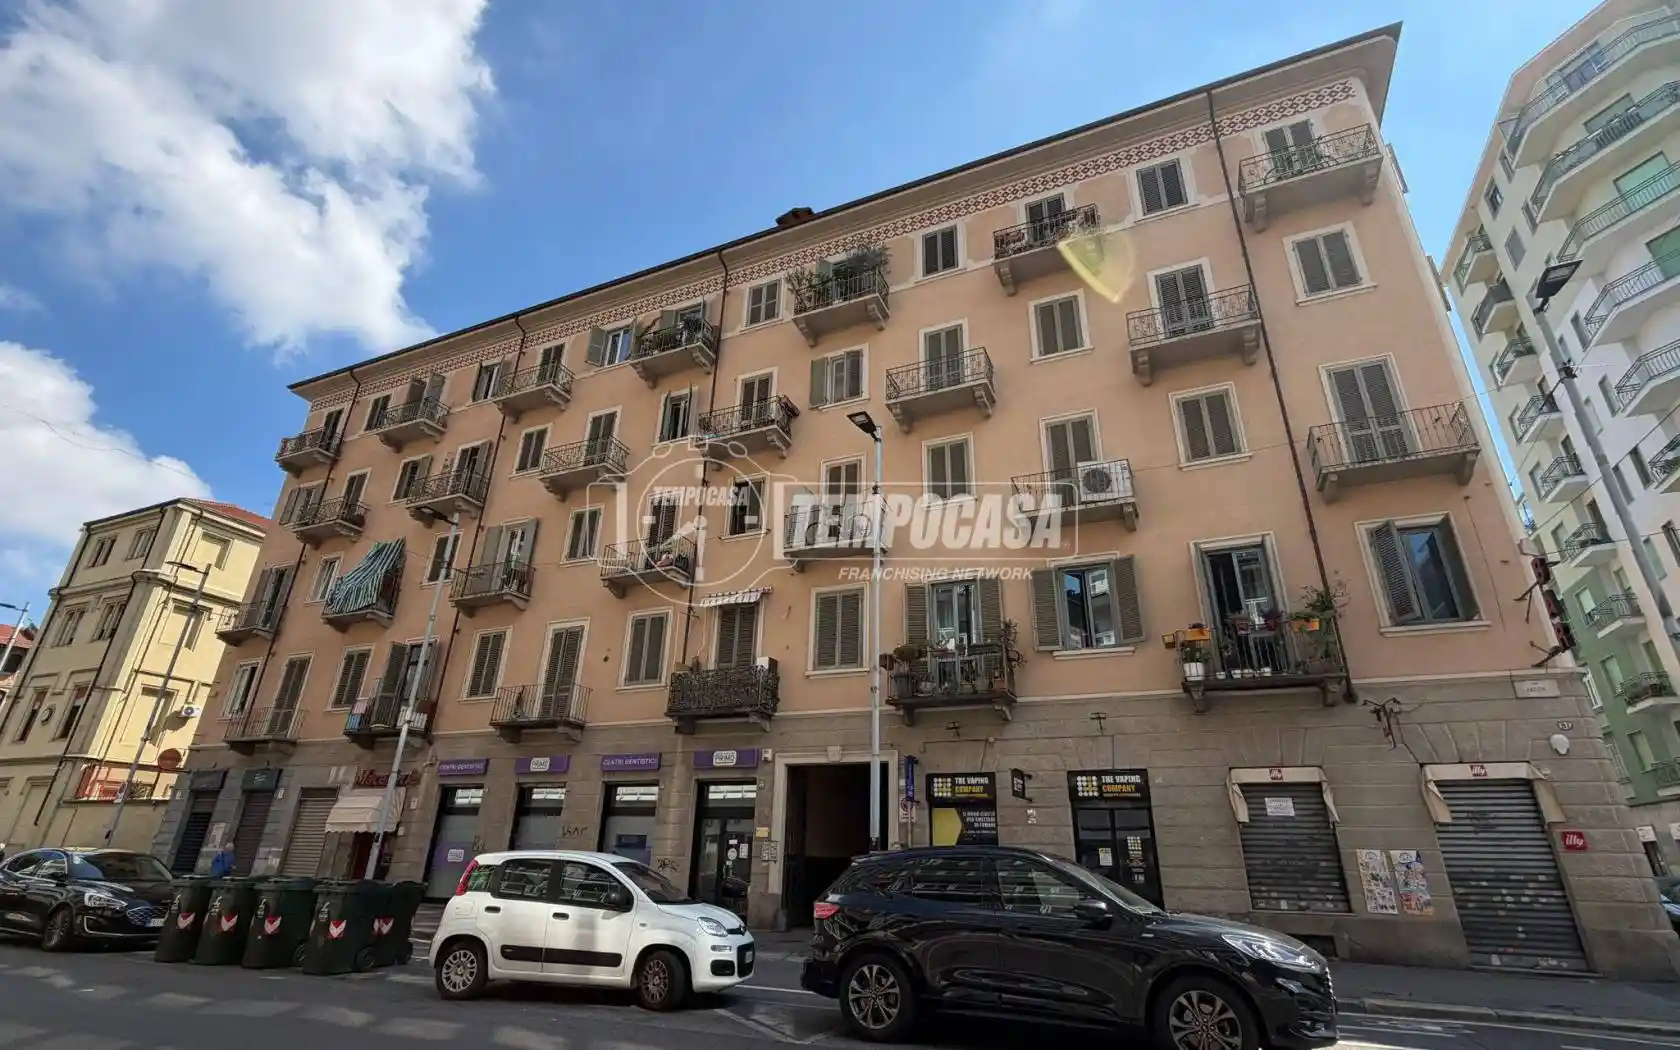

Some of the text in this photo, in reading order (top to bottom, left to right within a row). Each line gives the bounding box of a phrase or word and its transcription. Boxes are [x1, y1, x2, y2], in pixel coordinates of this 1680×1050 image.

[1472, 765, 1486, 776] illy
[967, 777, 989, 785] VAPING
[1115, 775, 1141, 783] VAPING
[955, 785, 984, 793] COMPANY
[1565, 834, 1584, 848] illy
